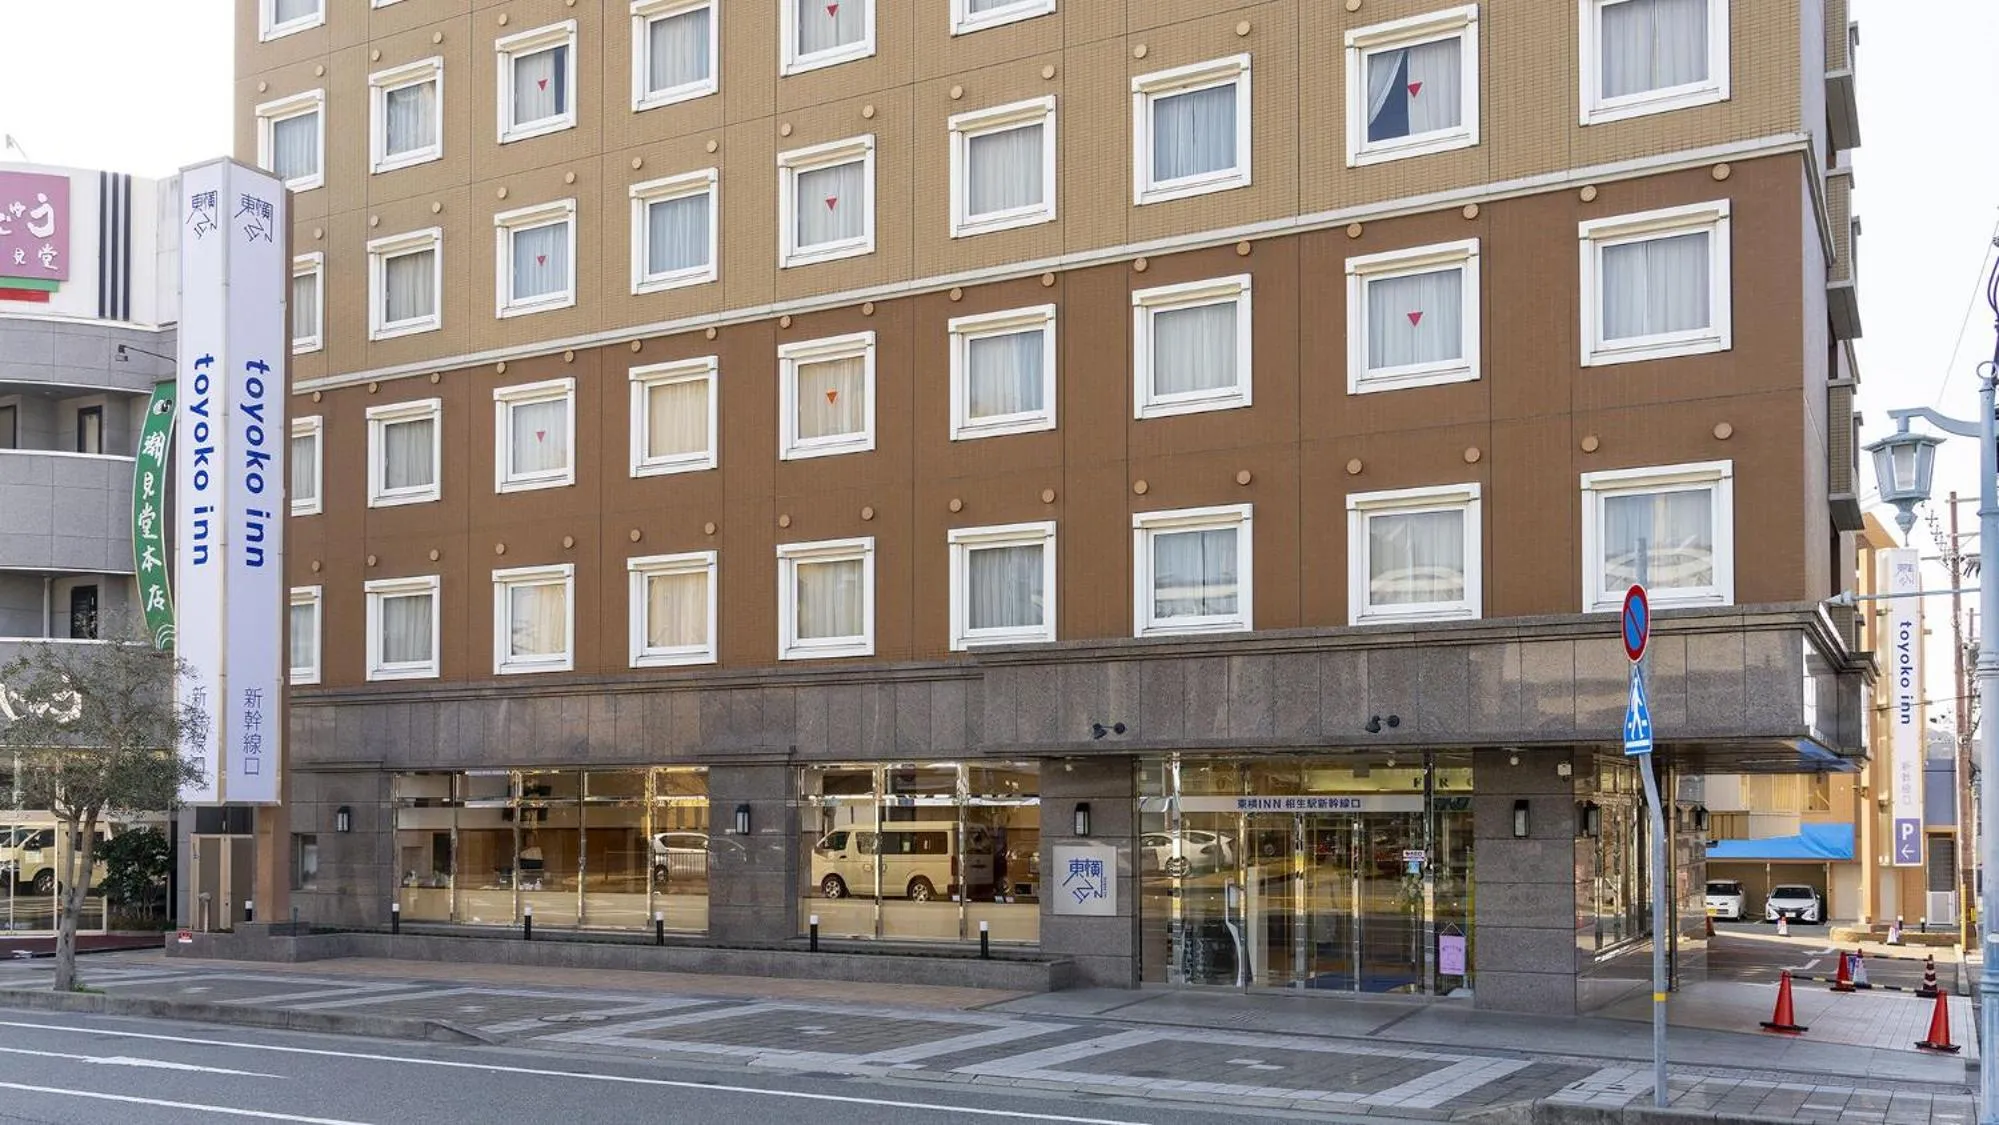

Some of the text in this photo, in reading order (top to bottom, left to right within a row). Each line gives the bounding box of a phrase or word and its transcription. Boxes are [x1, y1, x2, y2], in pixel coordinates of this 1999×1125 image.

[190, 353, 214, 565] toyoko inn
[240, 359, 271, 567] toyoko inn
[1897, 621, 1914, 725] toyoko inn
[243, 687, 263, 776] 新幹線口
[1902, 823, 1914, 841] P
